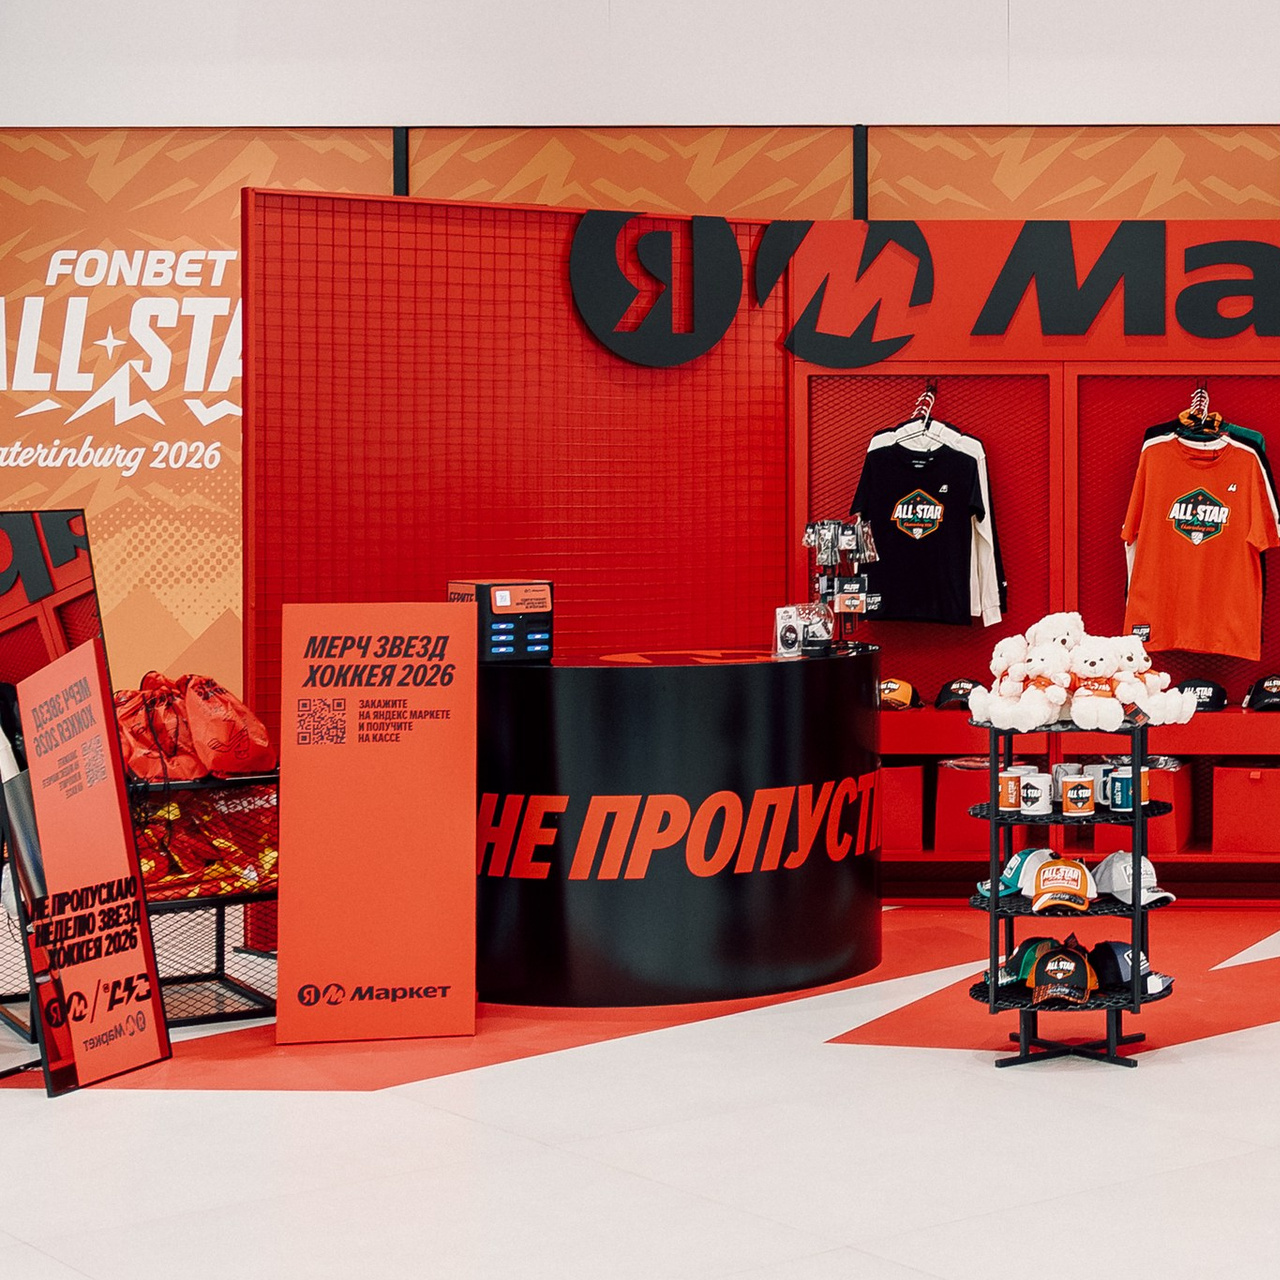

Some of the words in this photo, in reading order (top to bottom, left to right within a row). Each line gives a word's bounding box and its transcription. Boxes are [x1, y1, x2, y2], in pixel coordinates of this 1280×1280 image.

[45, 249, 238, 287] FONBET
[0, 296, 95, 391] LL
[0, 435, 147, 477] aterinburg
[149, 441, 222, 469] 2026
[894, 504, 914, 519] ALL
[916, 504, 943, 520] STAR
[1169, 503, 1193, 520] ALL
[1196, 504, 1230, 523] STAR
[303, 635, 373, 659] МЕРЧ
[373, 635, 450, 662] ЗВЕЗД
[301, 663, 398, 688] ХОККЕЯ
[396, 663, 456, 687] 2026
[358, 698, 408, 709] ЗАКАЖИТЕ
[358, 710, 371, 721] НА
[372, 710, 408, 721] ЯНДЕКС
[409, 709, 451, 720] МАРКЕТЕ
[358, 721, 364, 732] И
[366, 721, 413, 731] ПОЛУЧИТЕ
[358, 733, 370, 743] НА
[372, 732, 400, 742] КАССЕ
[477, 792, 570, 881] НЕ
[51, 875, 138, 917] ПРОПУСКАЮ
[35, 912, 96, 948] НЕДЕЛЮ
[98, 900, 141, 932] ЗВЕЗД
[48, 935, 103, 971] ХОККЕЯ
[104, 926, 138, 957] 2026
[350, 985, 452, 1003] Маркет
